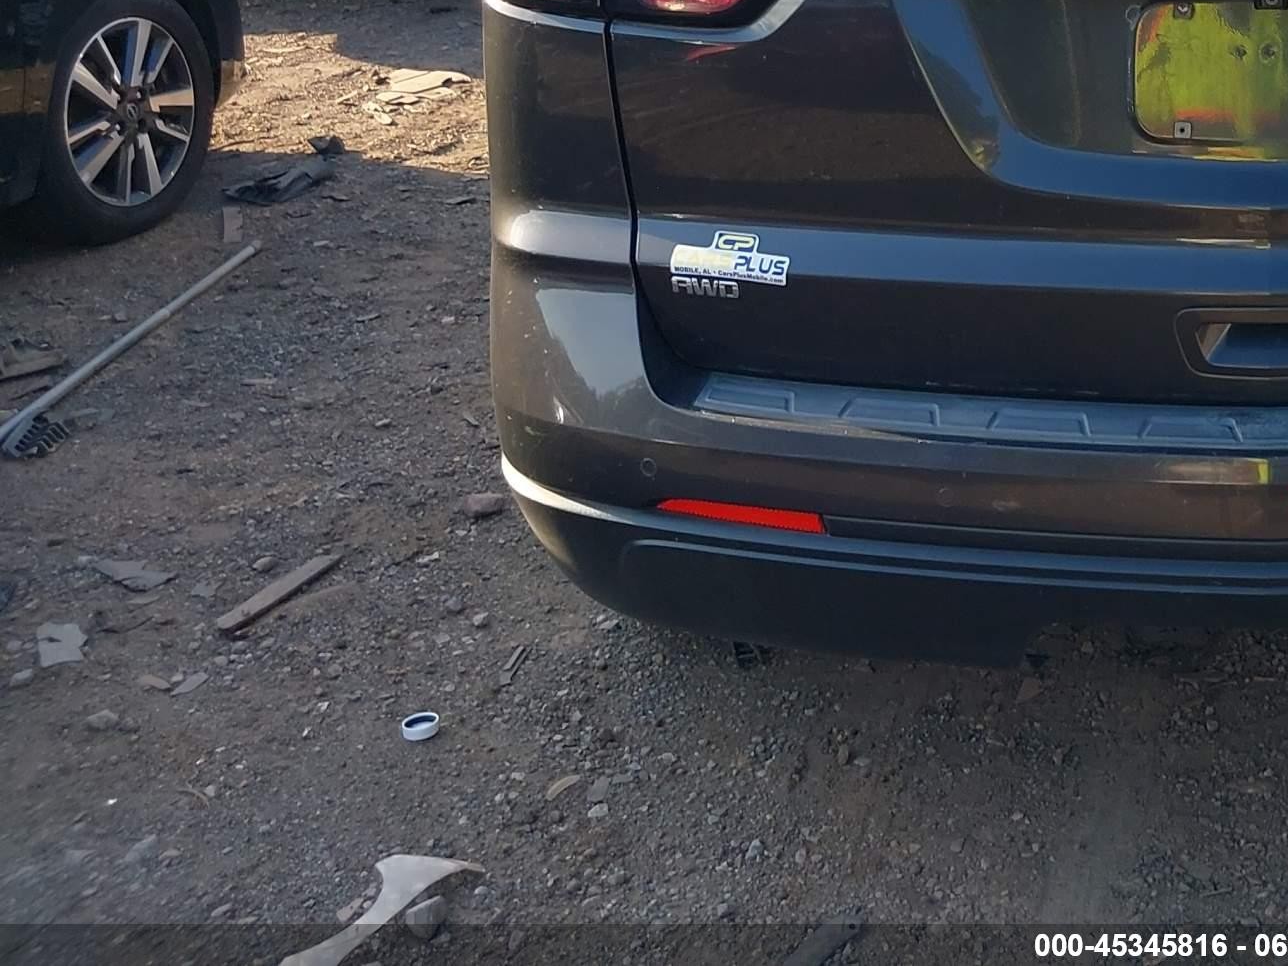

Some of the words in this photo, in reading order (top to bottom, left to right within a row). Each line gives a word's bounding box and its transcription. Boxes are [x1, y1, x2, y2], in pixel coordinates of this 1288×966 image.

[674, 266, 702, 275] MOBILE,
[717, 270, 784, 284] CarsPlusMobile.com
[734, 255, 787, 276] PLUS
[671, 275, 740, 299] AWD
